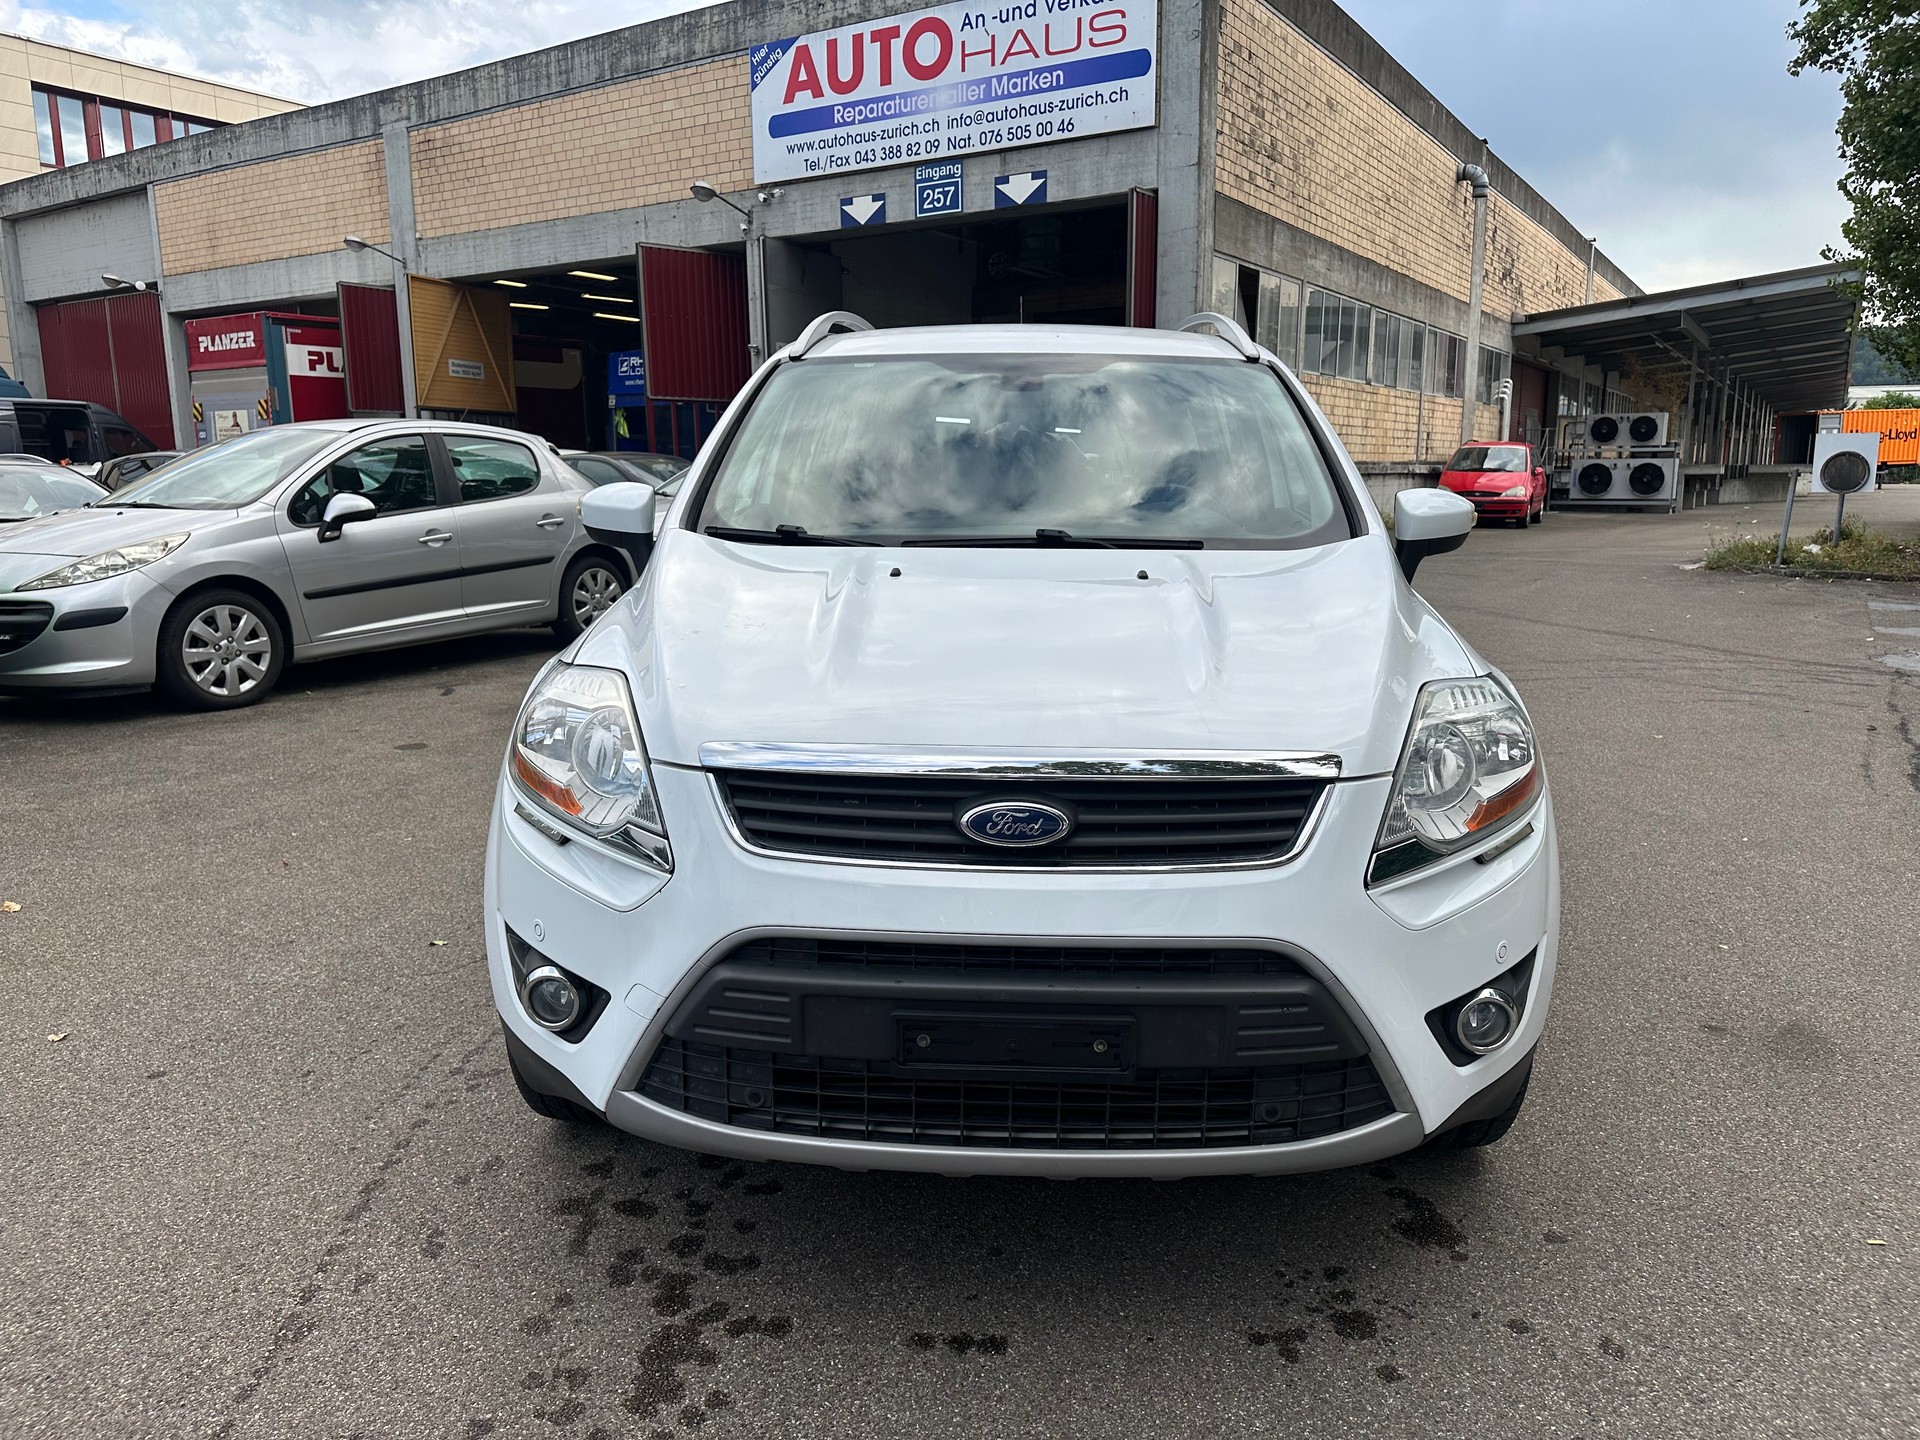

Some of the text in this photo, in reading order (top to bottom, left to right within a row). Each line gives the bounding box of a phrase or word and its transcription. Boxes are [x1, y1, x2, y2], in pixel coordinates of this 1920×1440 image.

[960, 12, 986, 32] An
[752, 44, 769, 65] Hier
[753, 48, 783, 84] günstig
[782, 9, 1127, 105] AUTO HAUS
[834, 70, 1064, 124] Reparaturen aller Marken
[786, 87, 1129, 154] www.autohaus-zurich.ch info@autohaus-zurich.ch
[804, 117, 1075, 173] Tel./Fax 043 388 82 09 Nat. 076 505 00 46
[916, 164, 961, 180] Eingang
[923, 186, 955, 209] 257
[198, 331, 256, 353] PLANZER
[307, 350, 345, 373] PL
[986, 810, 1043, 836] Ford
